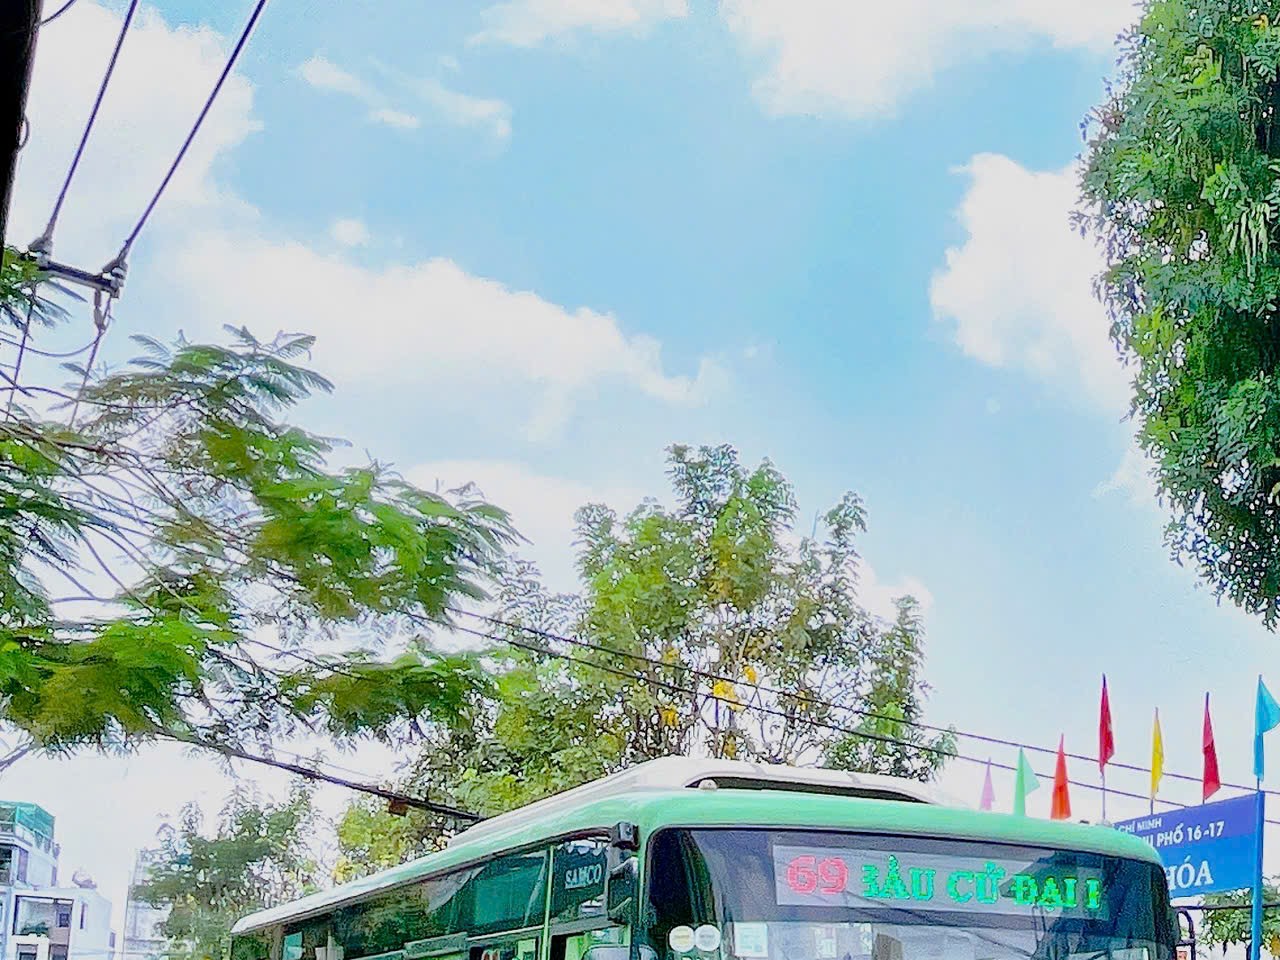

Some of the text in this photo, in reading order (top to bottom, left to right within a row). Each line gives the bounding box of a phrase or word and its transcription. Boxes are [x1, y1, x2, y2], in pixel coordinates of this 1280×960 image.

[1137, 818, 1163, 831] MINH
[1156, 822, 1184, 848] PHỐ
[565, 863, 603, 889] SAMCO
[786, 854, 849, 896] 69
